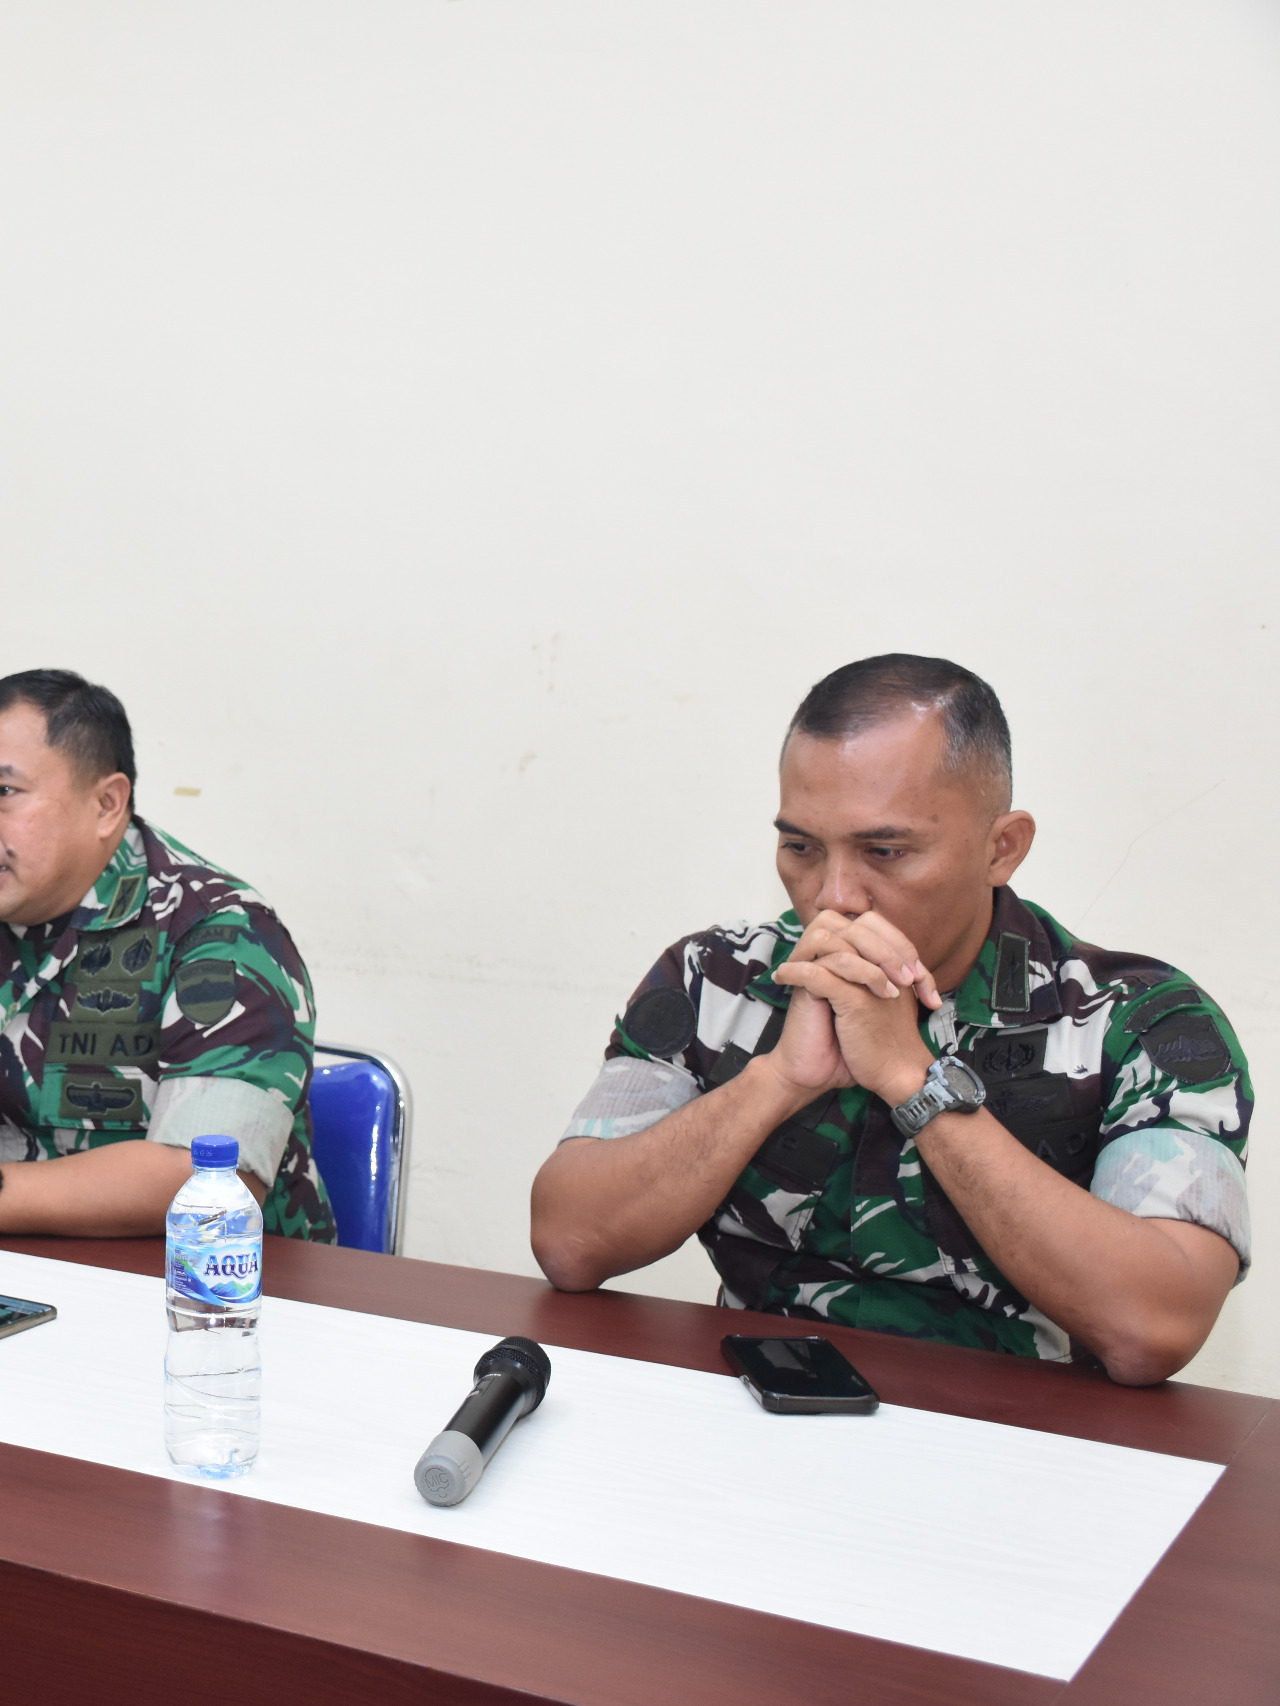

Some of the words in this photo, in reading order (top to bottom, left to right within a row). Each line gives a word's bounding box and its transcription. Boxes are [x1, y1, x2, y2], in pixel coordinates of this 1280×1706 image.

[59, 1031, 97, 1056] TNI
[109, 1033, 153, 1056] AD
[204, 1252, 259, 1280] AQUA
[426, 1472, 449, 1488] MIC
